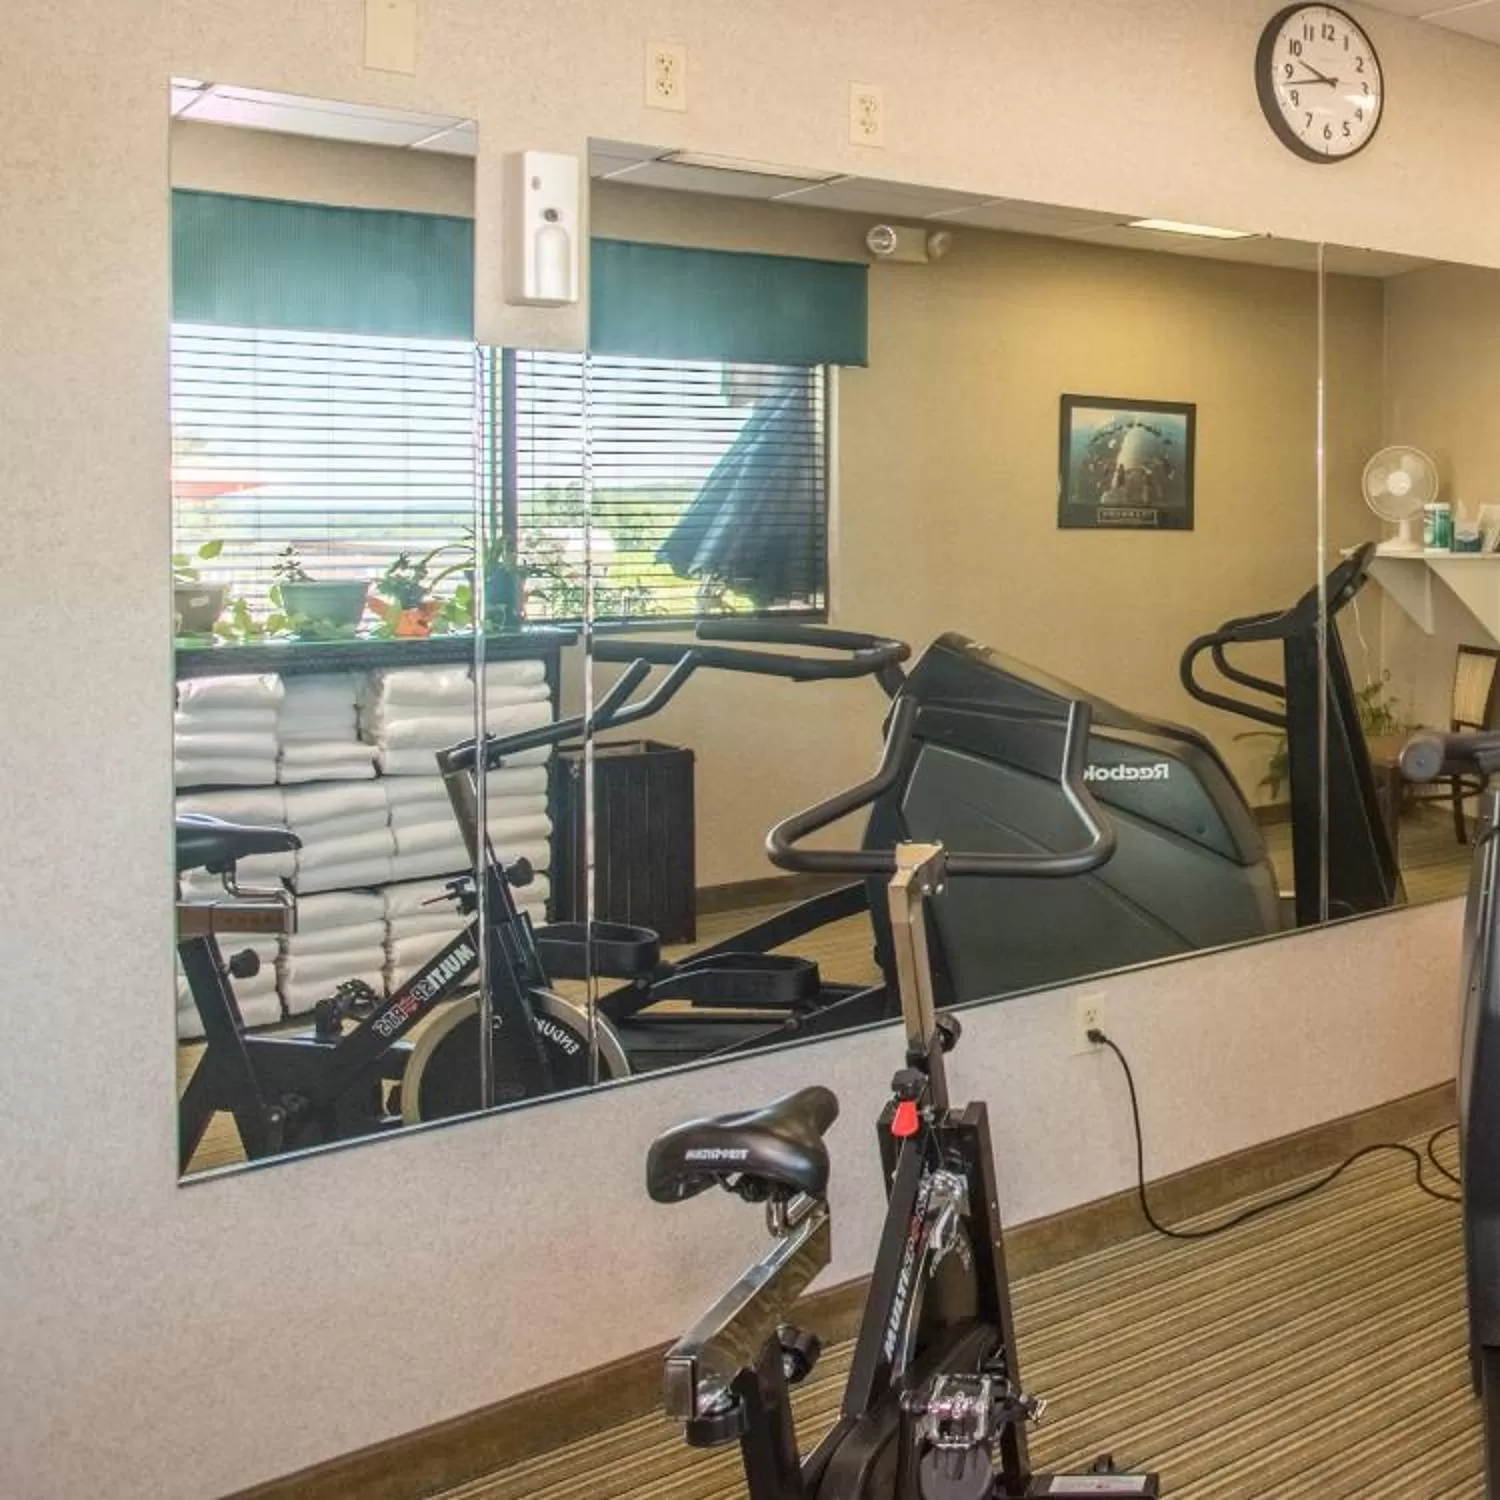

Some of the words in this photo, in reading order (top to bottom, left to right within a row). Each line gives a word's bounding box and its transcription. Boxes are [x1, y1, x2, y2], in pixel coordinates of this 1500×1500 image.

[1303, 23, 1314, 42] 11
[1321, 23, 1335, 41] 12
[1289, 38, 1303, 57] 10
[1284, 63, 1294, 79] 9
[1355, 56, 1364, 73] 2
[1361, 81, 1370, 95] 3
[1289, 90, 1299, 107] 8
[1305, 111, 1313, 129] 7
[1354, 107, 1363, 122] 4
[1323, 123, 1332, 141] 6
[1342, 121, 1351, 137] 5
